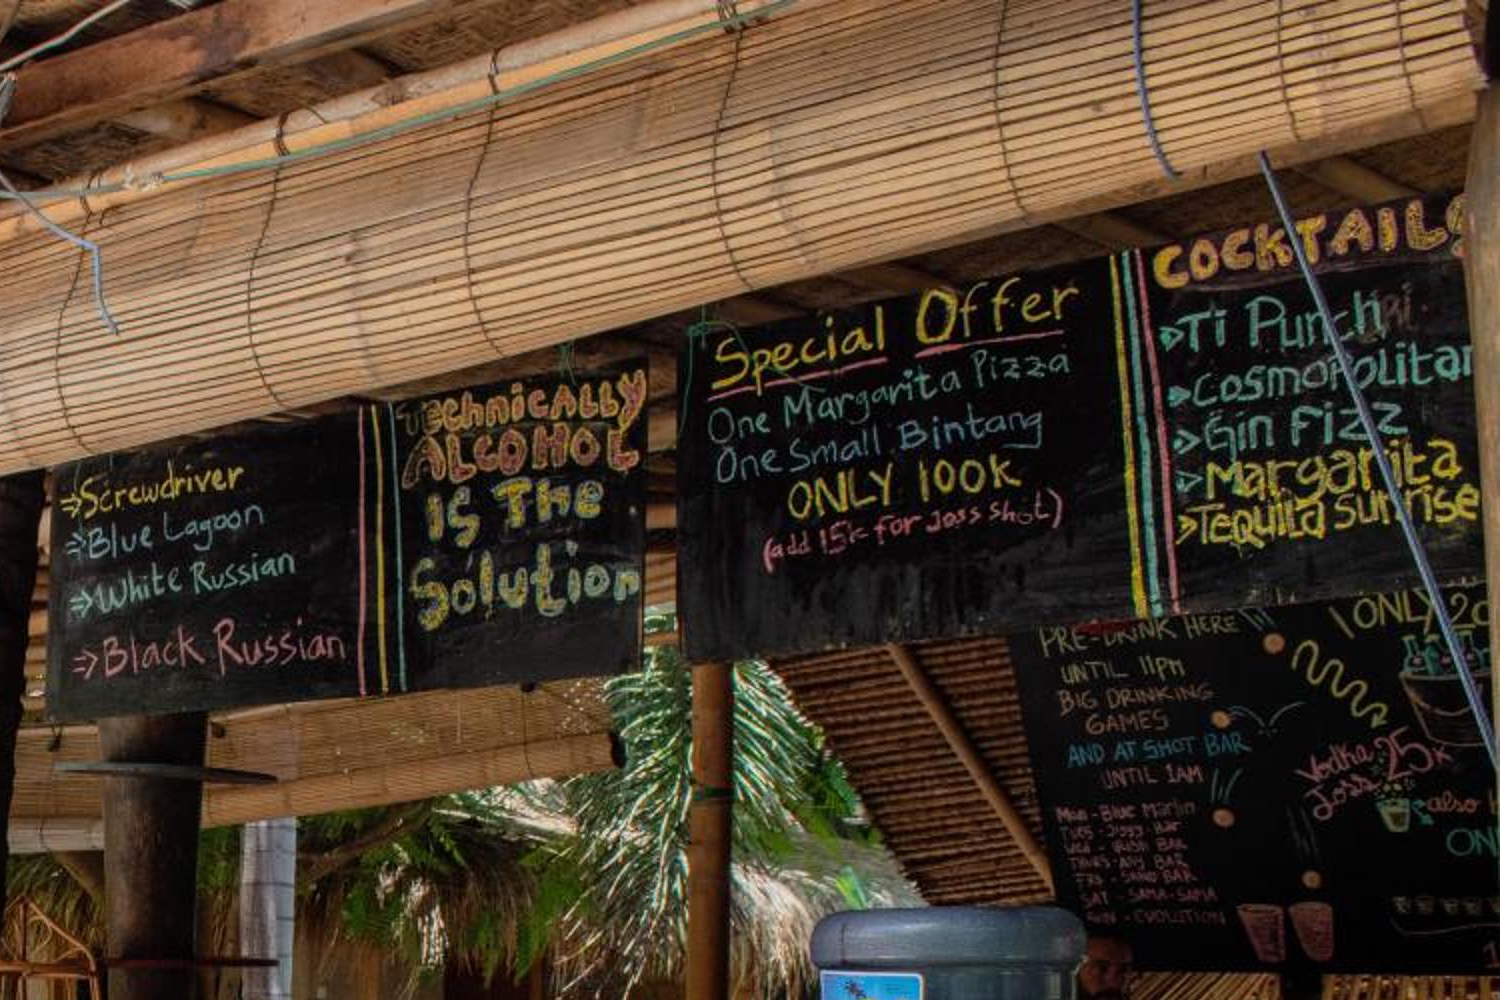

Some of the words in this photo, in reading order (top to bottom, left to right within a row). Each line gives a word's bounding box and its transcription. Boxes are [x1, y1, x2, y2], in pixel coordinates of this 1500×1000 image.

[713, 305, 887, 397] Special
[915, 277, 1079, 344] Offer
[708, 407, 771, 444] One
[784, 370, 962, 429] Margarita
[973, 348, 1071, 389] Pizza
[402, 422, 640, 490] ALCOHOL
[716, 445, 784, 483] One
[790, 426, 881, 474] Small
[899, 403, 1043, 452] Bintang
[1204, 410, 1275, 458] Gin
[79, 459, 245, 519] Screwdriver
[788, 462, 894, 521] ONLY
[1206, 439, 1463, 500] Margarita
[86, 524, 151, 560] Blue
[164, 503, 264, 553] Lagoon
[873, 512, 920, 546] for
[94, 562, 180, 616] White
[192, 552, 296, 595] Russian
[409, 540, 641, 632] Solution
[1353, 587, 1434, 636] ONLY
[104, 629, 205, 680] Black
[213, 617, 346, 676] Russian
[1183, 614, 1241, 640] HERE
[1057, 687, 1099, 717] BIG
[1105, 682, 1214, 709] DRINKING
[1060, 660, 1130, 685] UNTIL
[1066, 742, 1105, 769] AND
[1114, 741, 1138, 763] AT
[1142, 735, 1197, 760] SHOT
[1203, 730, 1253, 758] BAR
[1085, 709, 1170, 736] GAMES
[1100, 766, 1160, 790] UNTIL
